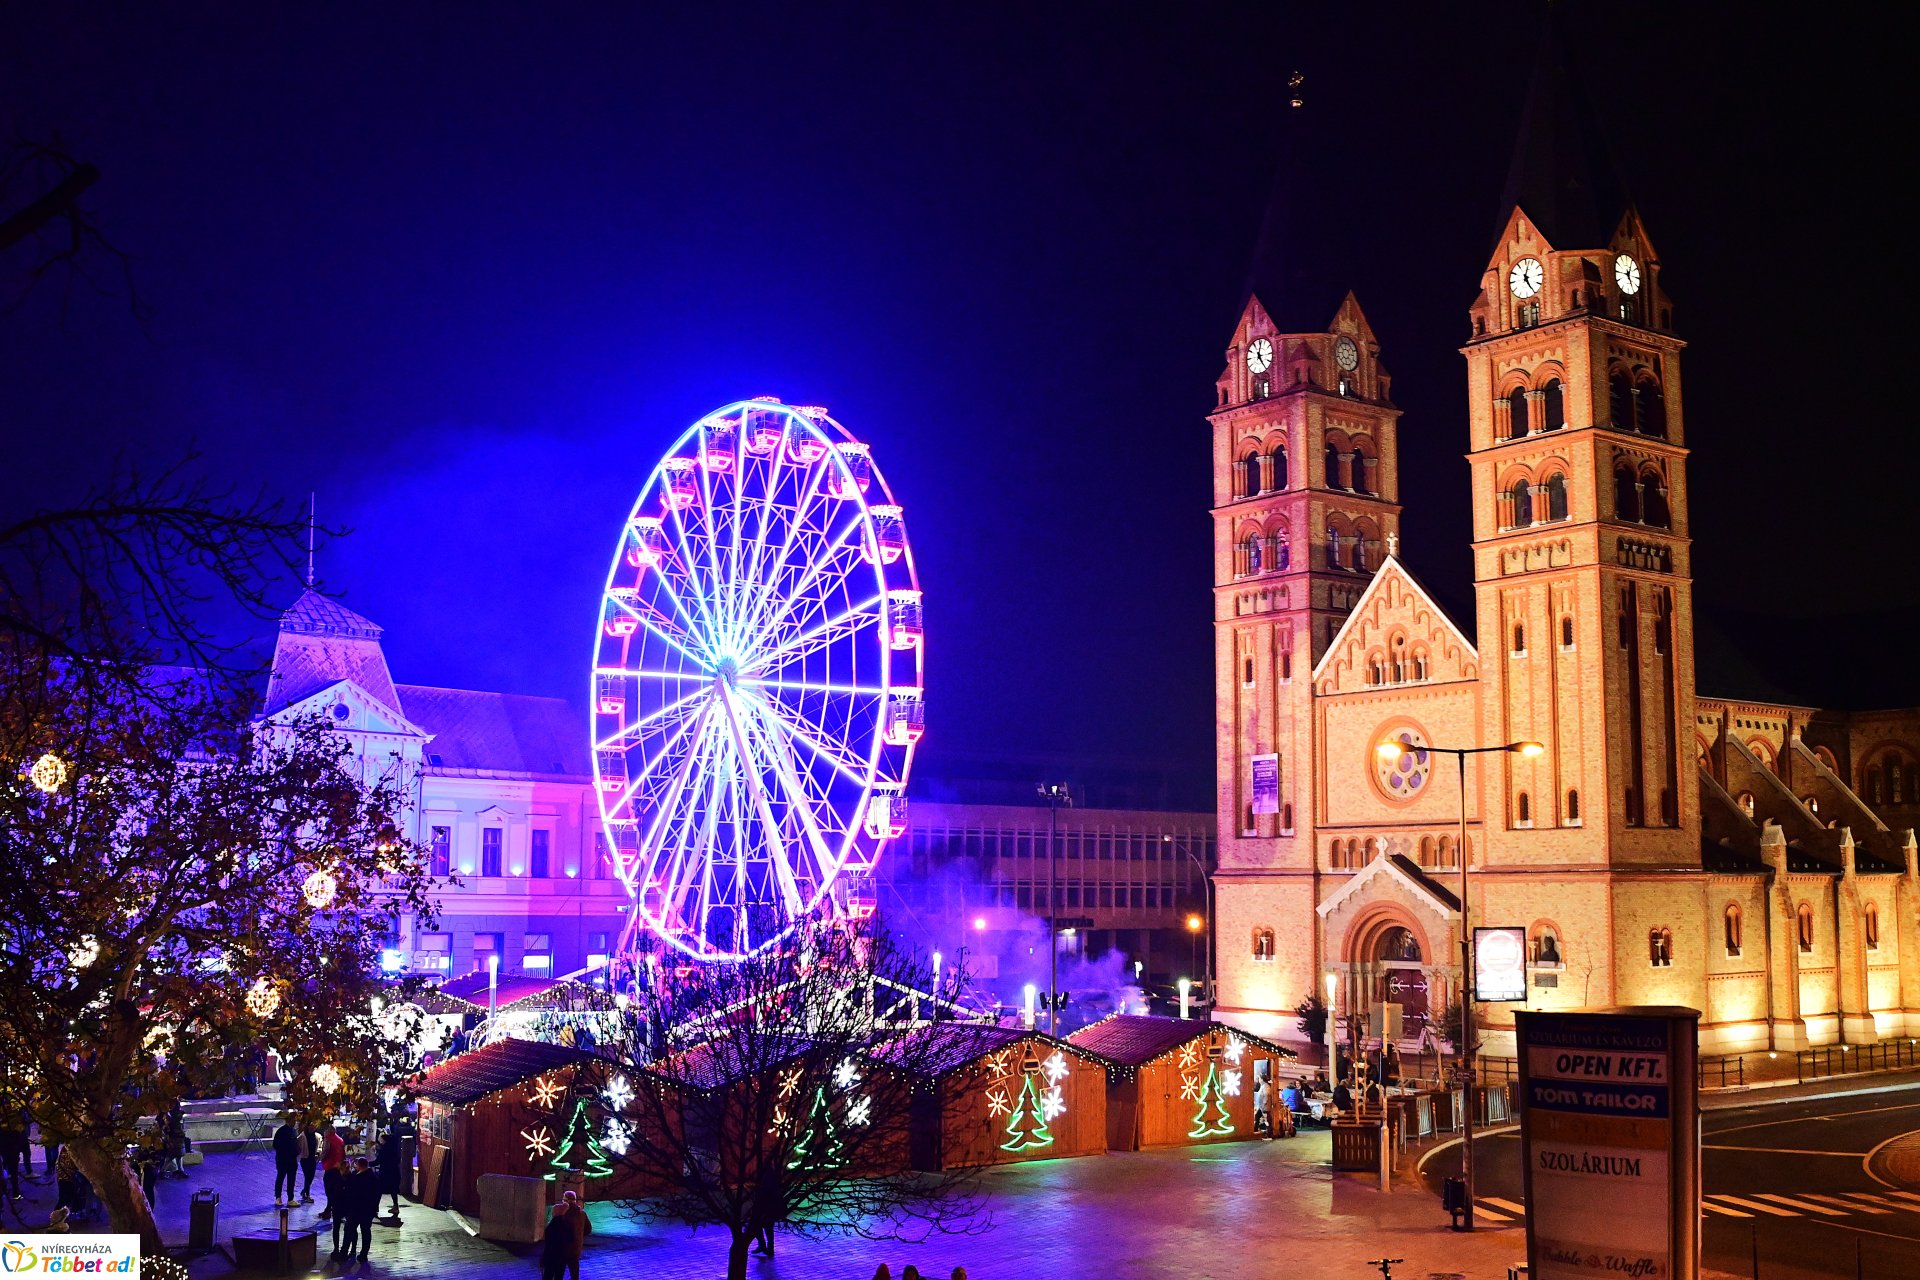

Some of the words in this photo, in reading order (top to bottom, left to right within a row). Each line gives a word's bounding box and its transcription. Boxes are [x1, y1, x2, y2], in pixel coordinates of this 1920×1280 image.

[1556, 1053, 1611, 1077] OPEN
[1617, 1057, 1663, 1079] KFT.
[1534, 1087, 1579, 1105] TOM
[1582, 1091, 1656, 1110] TAILOR
[1540, 1150, 1641, 1177] SZOLÁRIUM
[1604, 1255, 1658, 1277] Waffle
